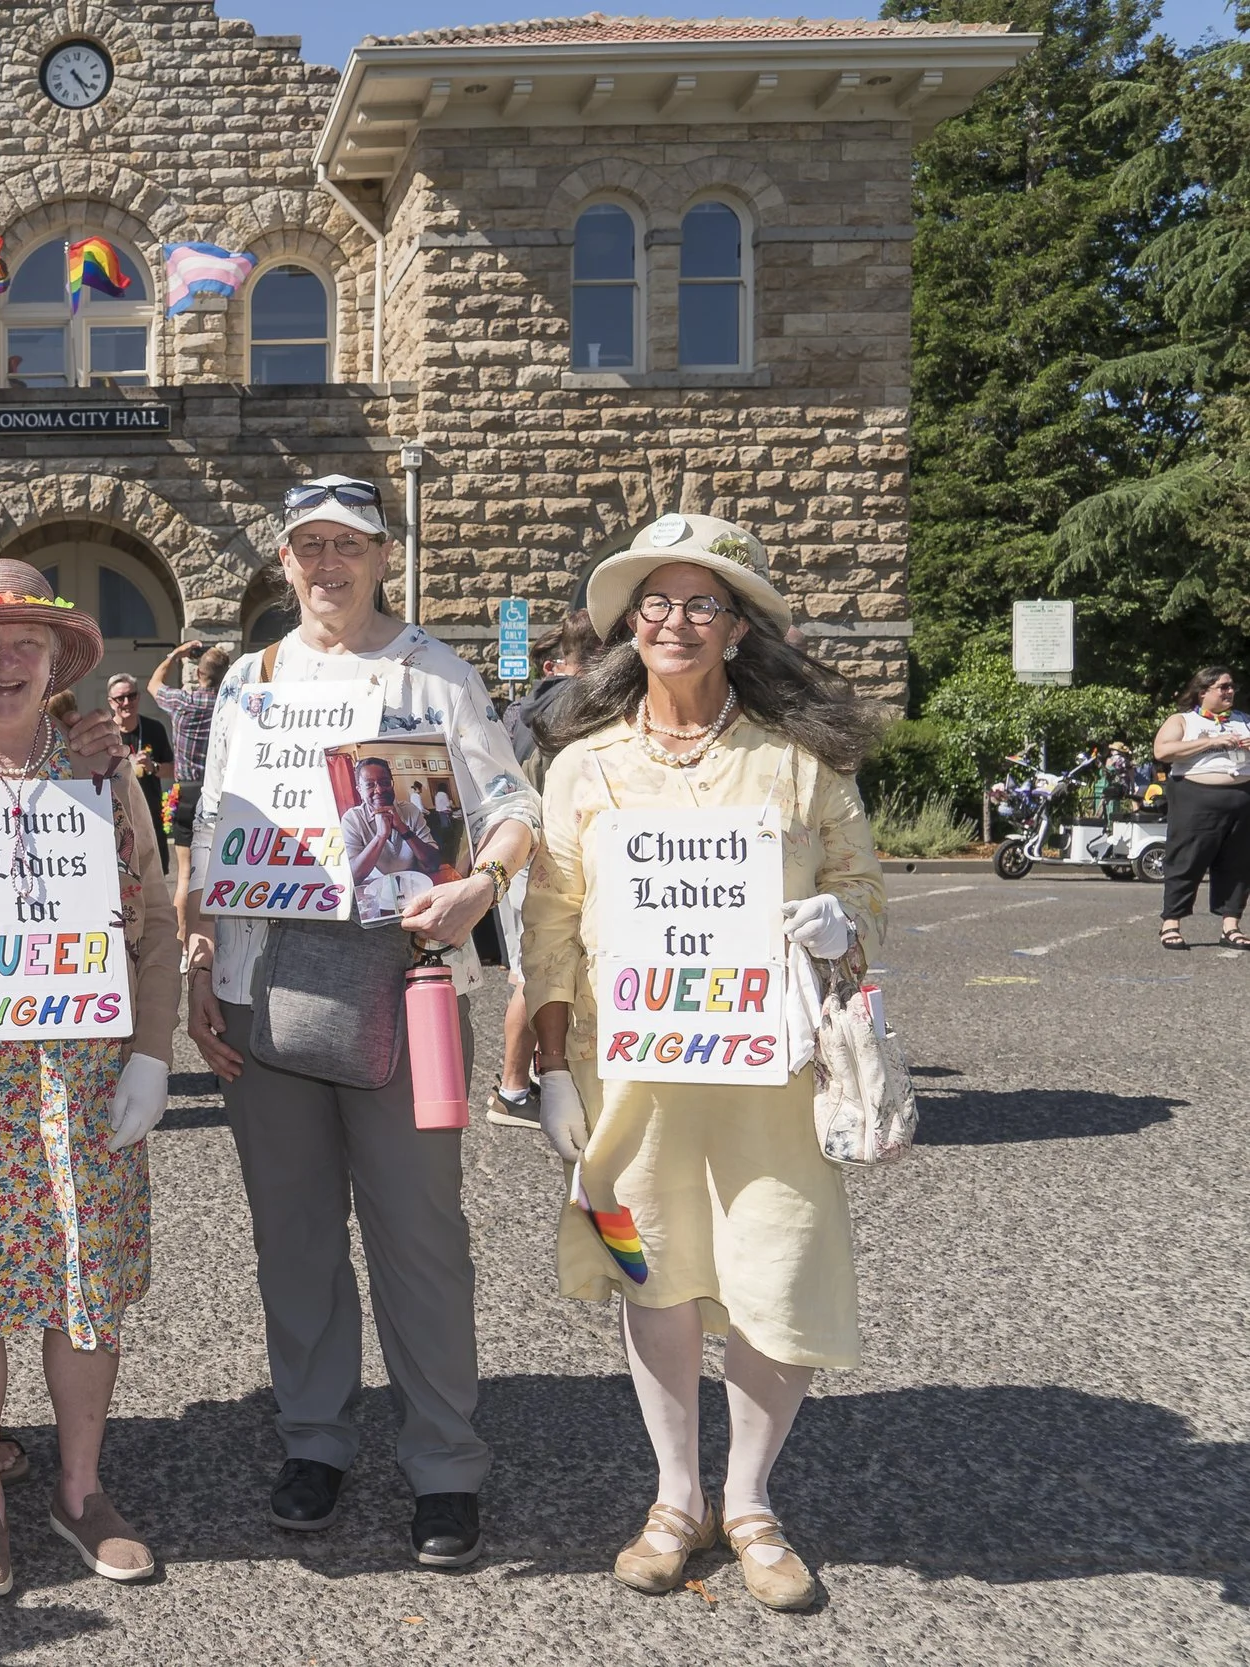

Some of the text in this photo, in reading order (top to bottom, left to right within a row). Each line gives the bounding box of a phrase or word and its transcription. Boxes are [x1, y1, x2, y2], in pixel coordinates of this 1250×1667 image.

[69, 411, 109, 427] CITY
[115, 410, 160, 426] HALL
[501, 621, 526, 630] PARKING
[505, 631, 522, 640] ONLY
[258, 701, 354, 732] Church
[254, 741, 327, 769] Ladi
[272, 783, 313, 809] for
[221, 827, 345, 867] QUEER
[626, 830, 748, 866] Church
[205, 879, 345, 912] RIGHTS
[629, 876, 746, 911] Ladies
[664, 925, 714, 957] for
[613, 967, 771, 1013] QUEER
[606, 1030, 777, 1067] RIGHTS
